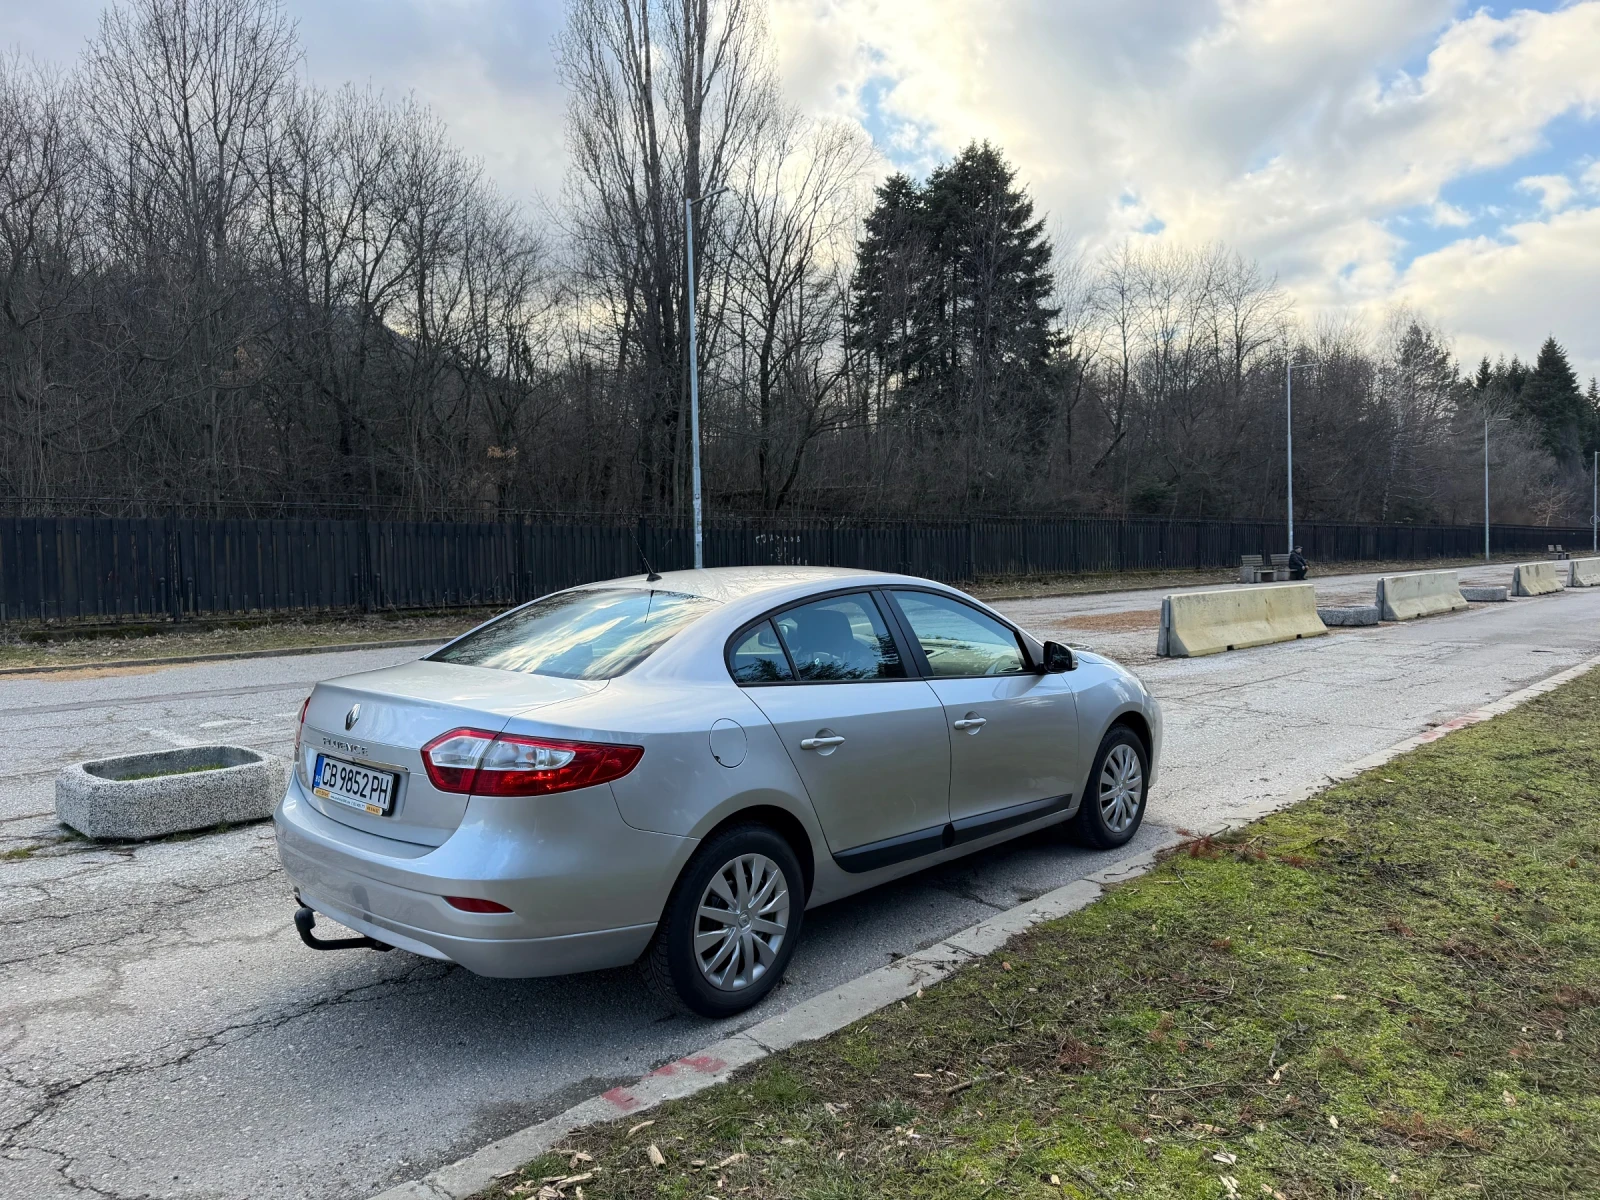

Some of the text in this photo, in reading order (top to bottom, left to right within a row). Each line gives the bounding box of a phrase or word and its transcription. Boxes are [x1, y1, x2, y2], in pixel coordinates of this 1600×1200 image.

[322, 762, 338, 788] CB
[339, 767, 369, 799] 9852
[369, 775, 389, 805] PH
